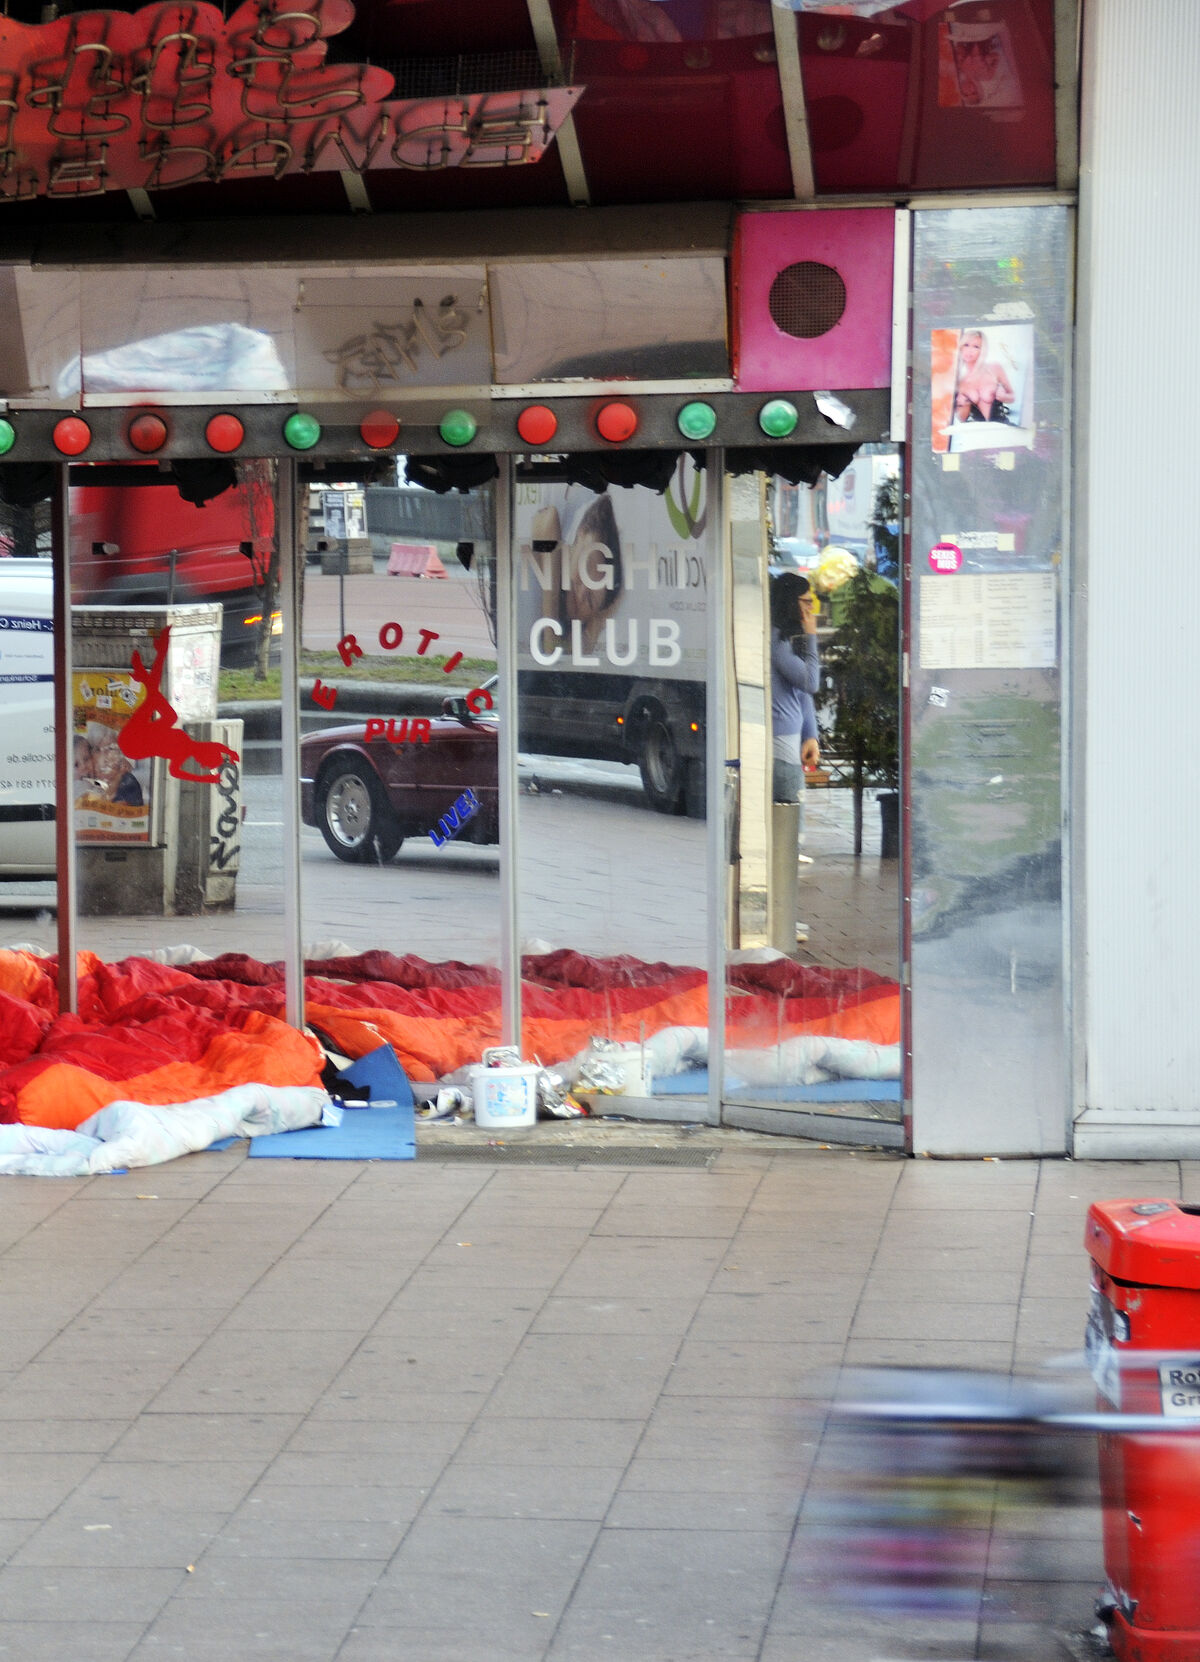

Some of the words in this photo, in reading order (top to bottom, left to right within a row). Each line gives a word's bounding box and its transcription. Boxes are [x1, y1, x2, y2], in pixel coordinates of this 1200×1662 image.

[138, 100, 547, 191] DANCE
[519, 541, 697, 591] NIGHT
[529, 617, 682, 667] CLUB
[311, 622, 494, 715] EROTIC
[363, 718, 431, 744] PUR
[428, 787, 481, 850] LIVE!
[1169, 1369, 1200, 1387] Ro
